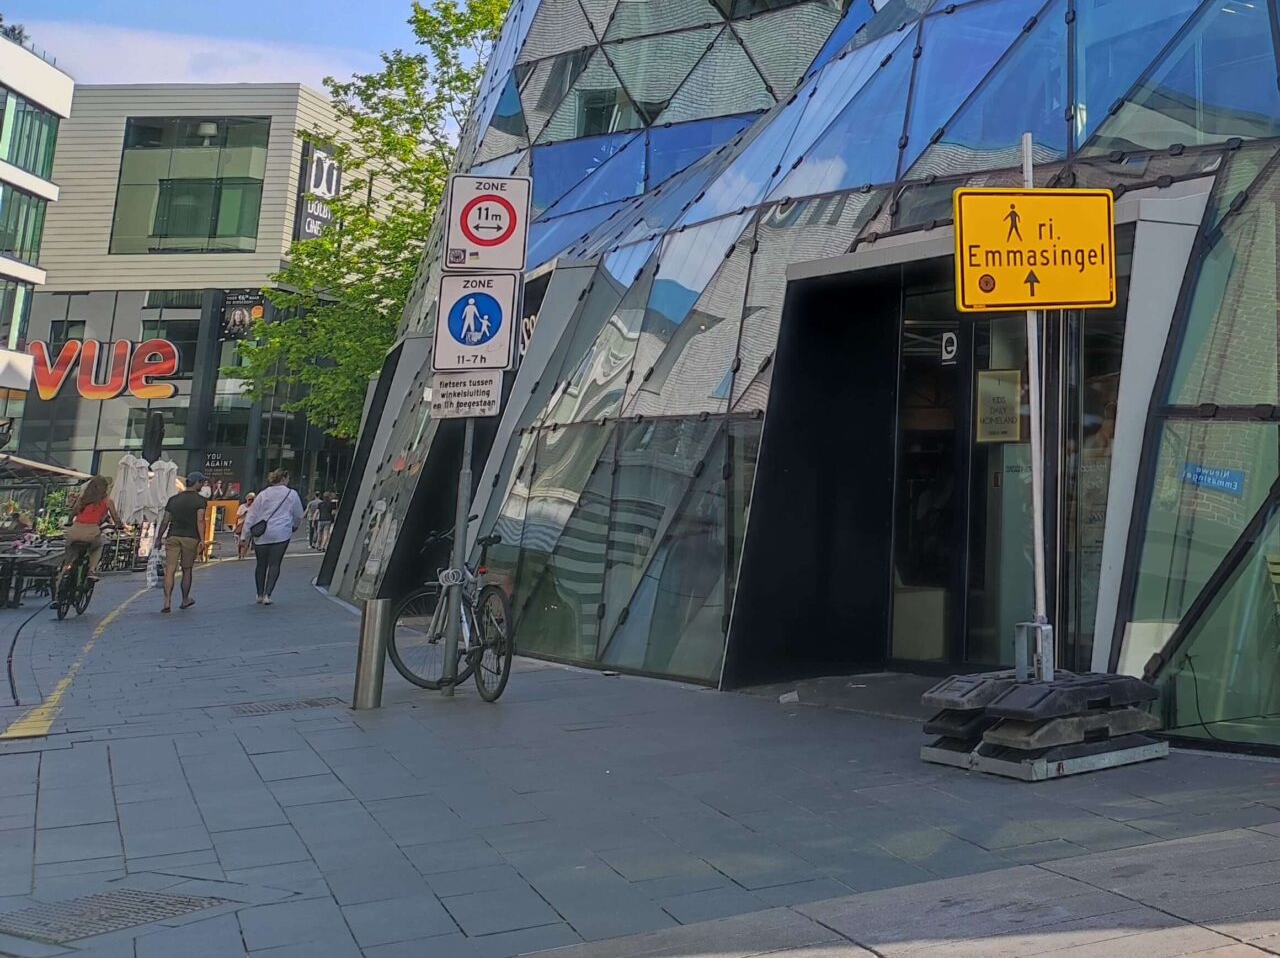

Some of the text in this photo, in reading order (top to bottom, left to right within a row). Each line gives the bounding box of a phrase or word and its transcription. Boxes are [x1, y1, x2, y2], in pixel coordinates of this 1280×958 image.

[475, 181, 508, 191] ZONE
[1038, 217, 1061, 240] ri.
[968, 243, 1105, 273] Emmasingel
[462, 279, 494, 289] ZONE
[439, 379, 494, 389] fietsers tussen
[440, 389, 491, 399] winkelsluiting
[432, 402, 442, 410] en
[456, 399, 496, 409] toegestaan
